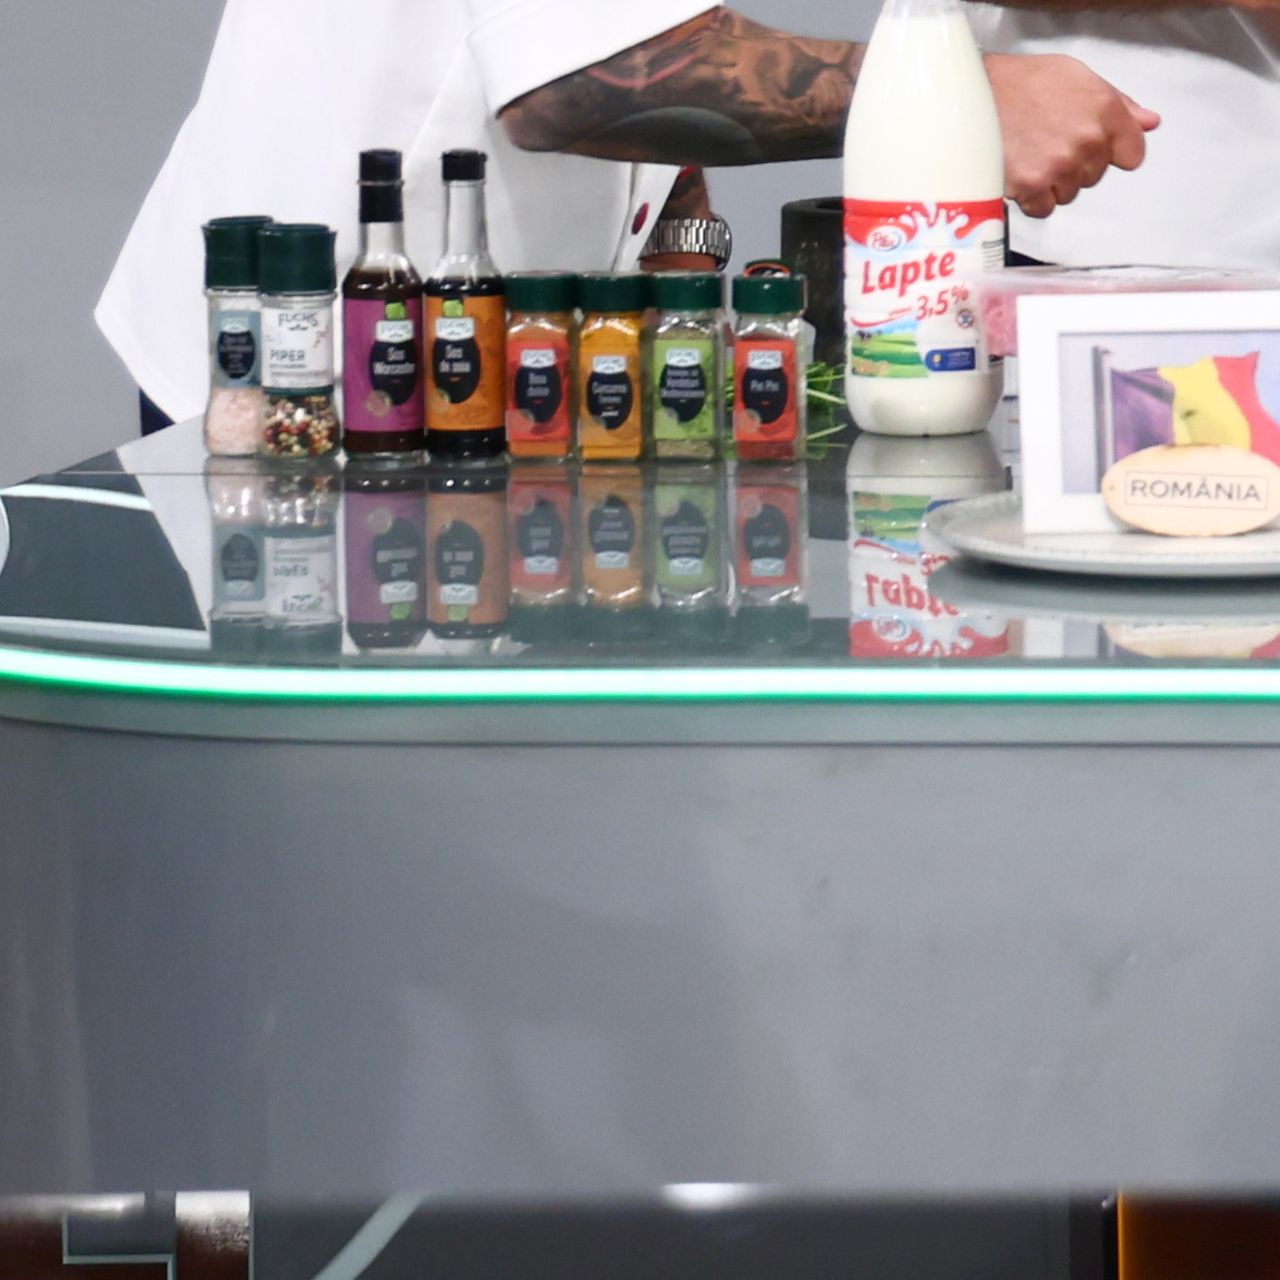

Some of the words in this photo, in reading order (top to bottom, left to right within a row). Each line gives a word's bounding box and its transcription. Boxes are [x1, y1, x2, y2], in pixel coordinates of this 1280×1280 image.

[861, 250, 956, 297] Lapte
[270, 350, 305, 361] PIPER
[1131, 477, 1261, 502] ROMÂNIA
